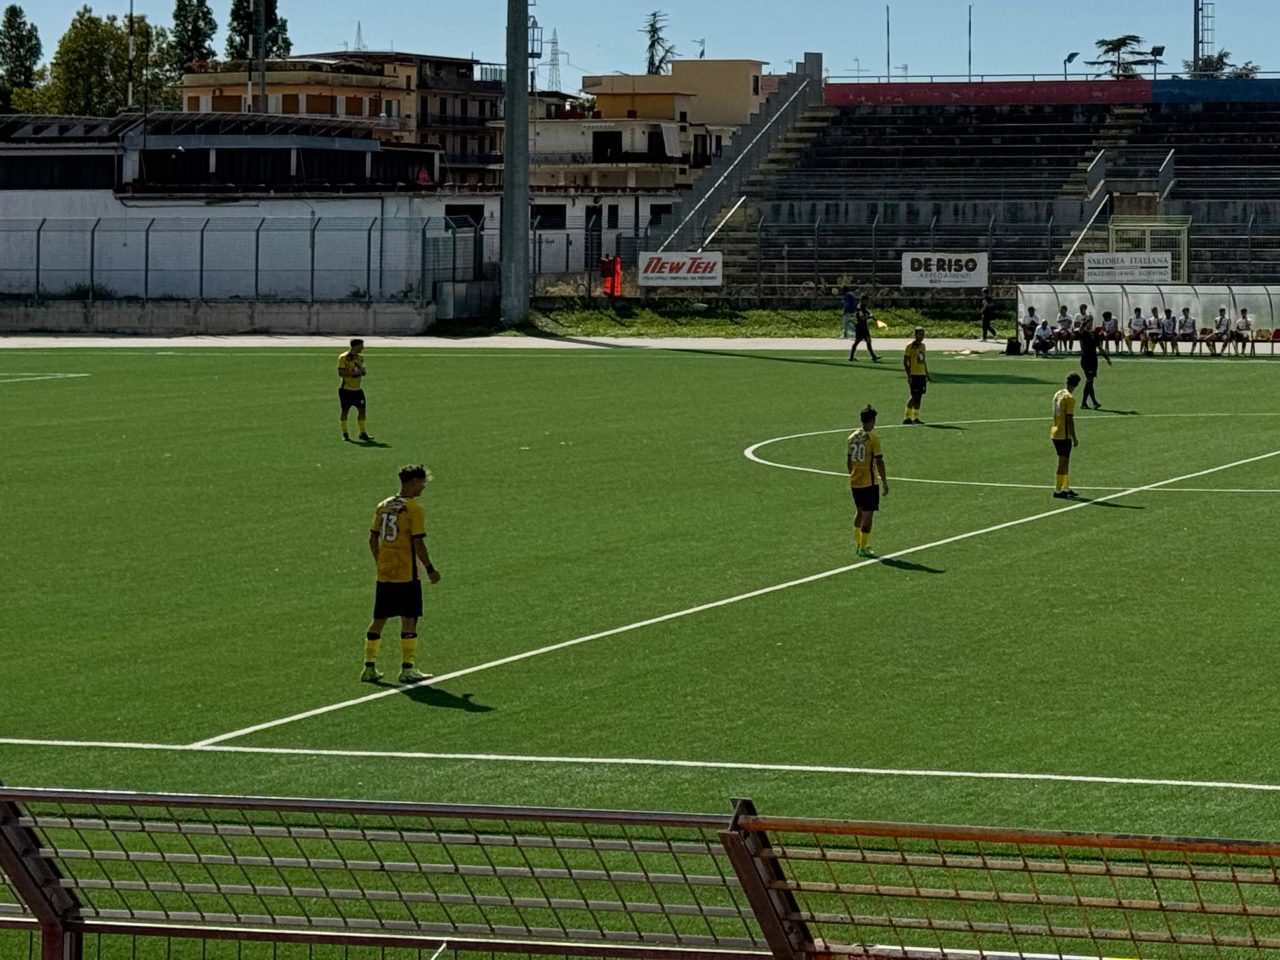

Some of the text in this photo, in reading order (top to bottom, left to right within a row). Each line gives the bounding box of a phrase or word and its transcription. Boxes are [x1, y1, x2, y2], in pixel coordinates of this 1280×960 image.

[910, 257, 978, 273] DE RISO
[1129, 256, 1169, 265] ITALIANA
[850, 443, 865, 462] 20
[382, 512, 399, 543] 13
